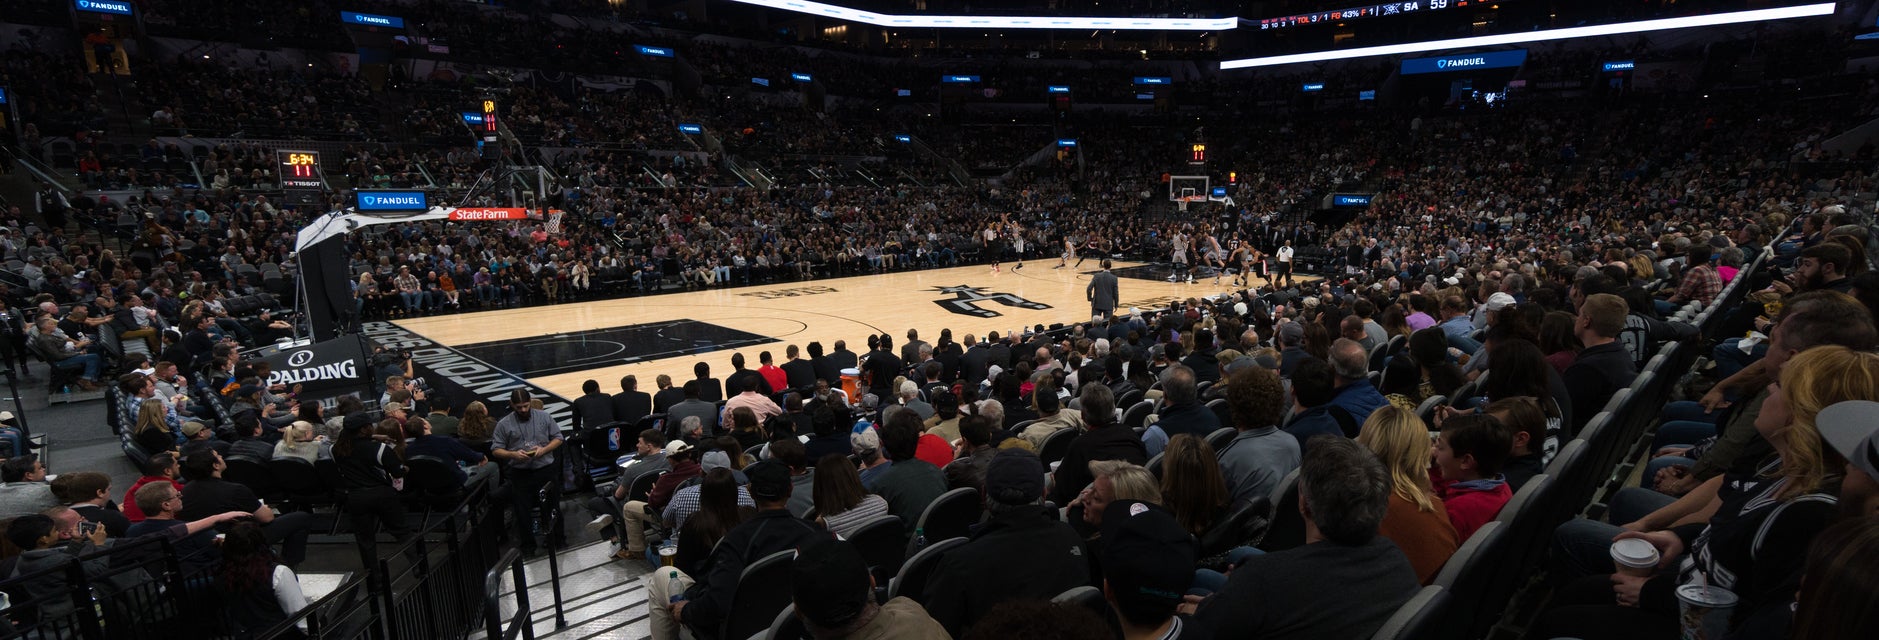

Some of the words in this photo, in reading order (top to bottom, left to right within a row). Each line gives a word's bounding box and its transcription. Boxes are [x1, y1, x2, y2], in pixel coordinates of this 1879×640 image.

[91, 2, 128, 11] FANDUEL
[1404, 2, 1418, 11] SA
[1430, 0, 1447, 9] 59
[363, 16, 390, 24] FANDUEL
[1297, 16, 1310, 24] TOL
[1331, 12, 1341, 20] FG
[1342, 9, 1359, 18] 43%
[1447, 57, 1485, 67] FANDUEL
[289, 153, 314, 165] 6:34
[295, 165, 311, 176] 11
[377, 197, 420, 205] FANDUEL
[456, 209, 482, 219] State
[483, 209, 508, 219] Farm
[266, 359, 358, 386] PALDING
